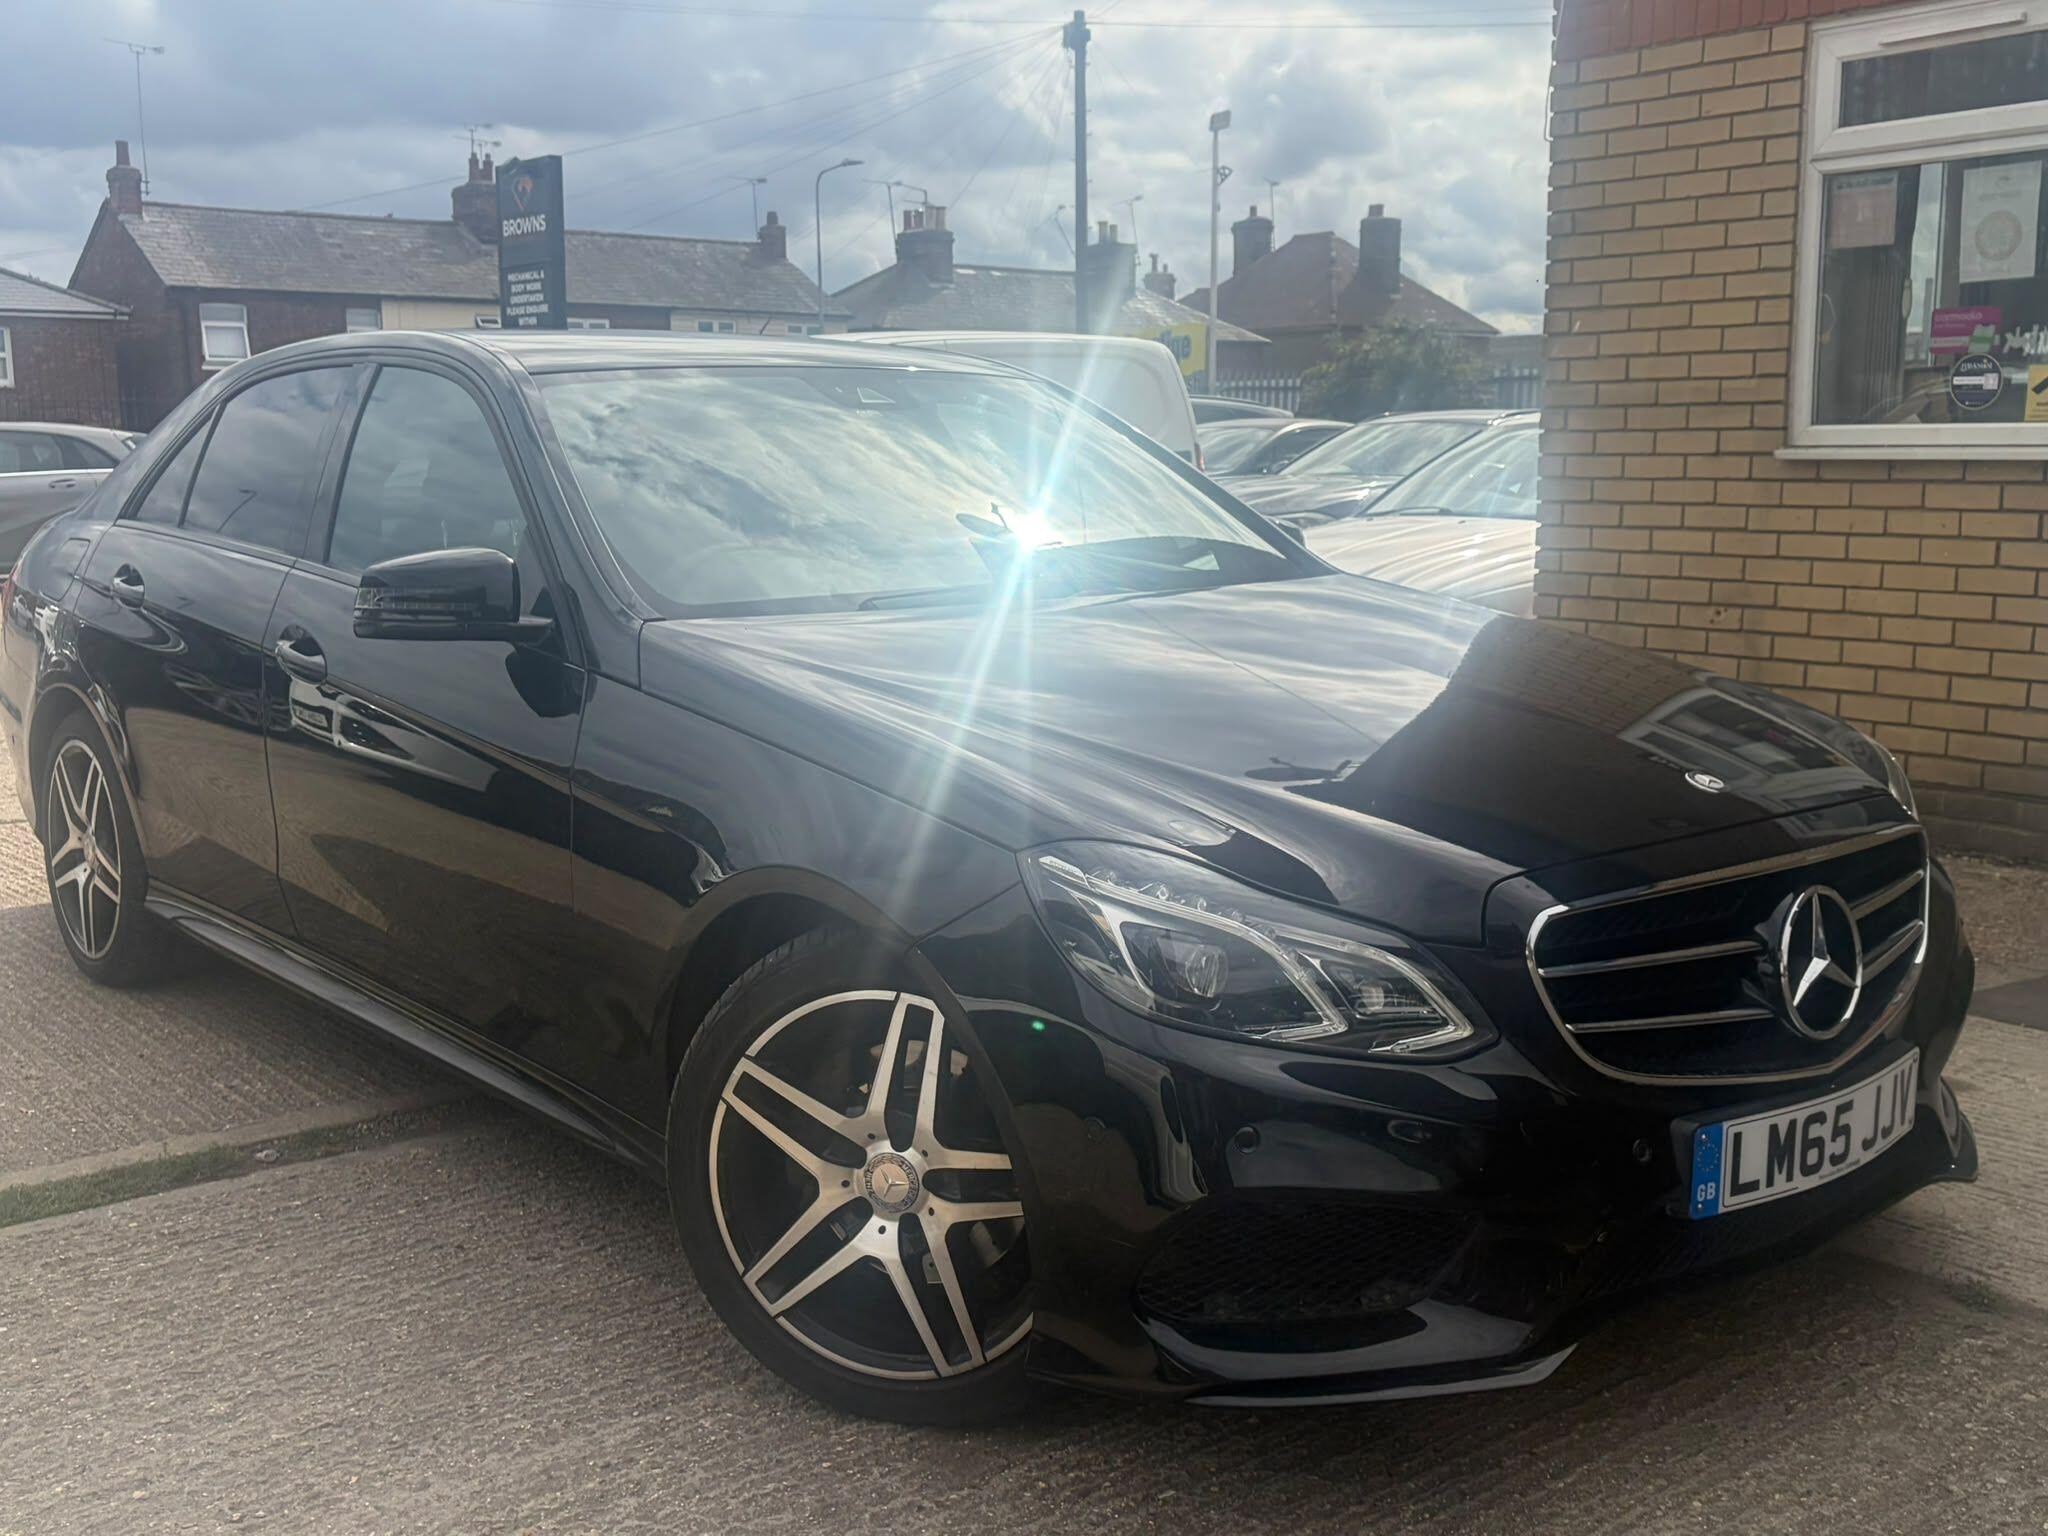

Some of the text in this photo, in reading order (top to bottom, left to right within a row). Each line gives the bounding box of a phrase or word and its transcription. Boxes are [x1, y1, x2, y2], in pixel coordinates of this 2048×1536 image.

[503, 214, 546, 236] BROWNS
[1730, 1063, 1913, 1197] LM65 JJV
[1696, 1181, 1716, 1200] GB
